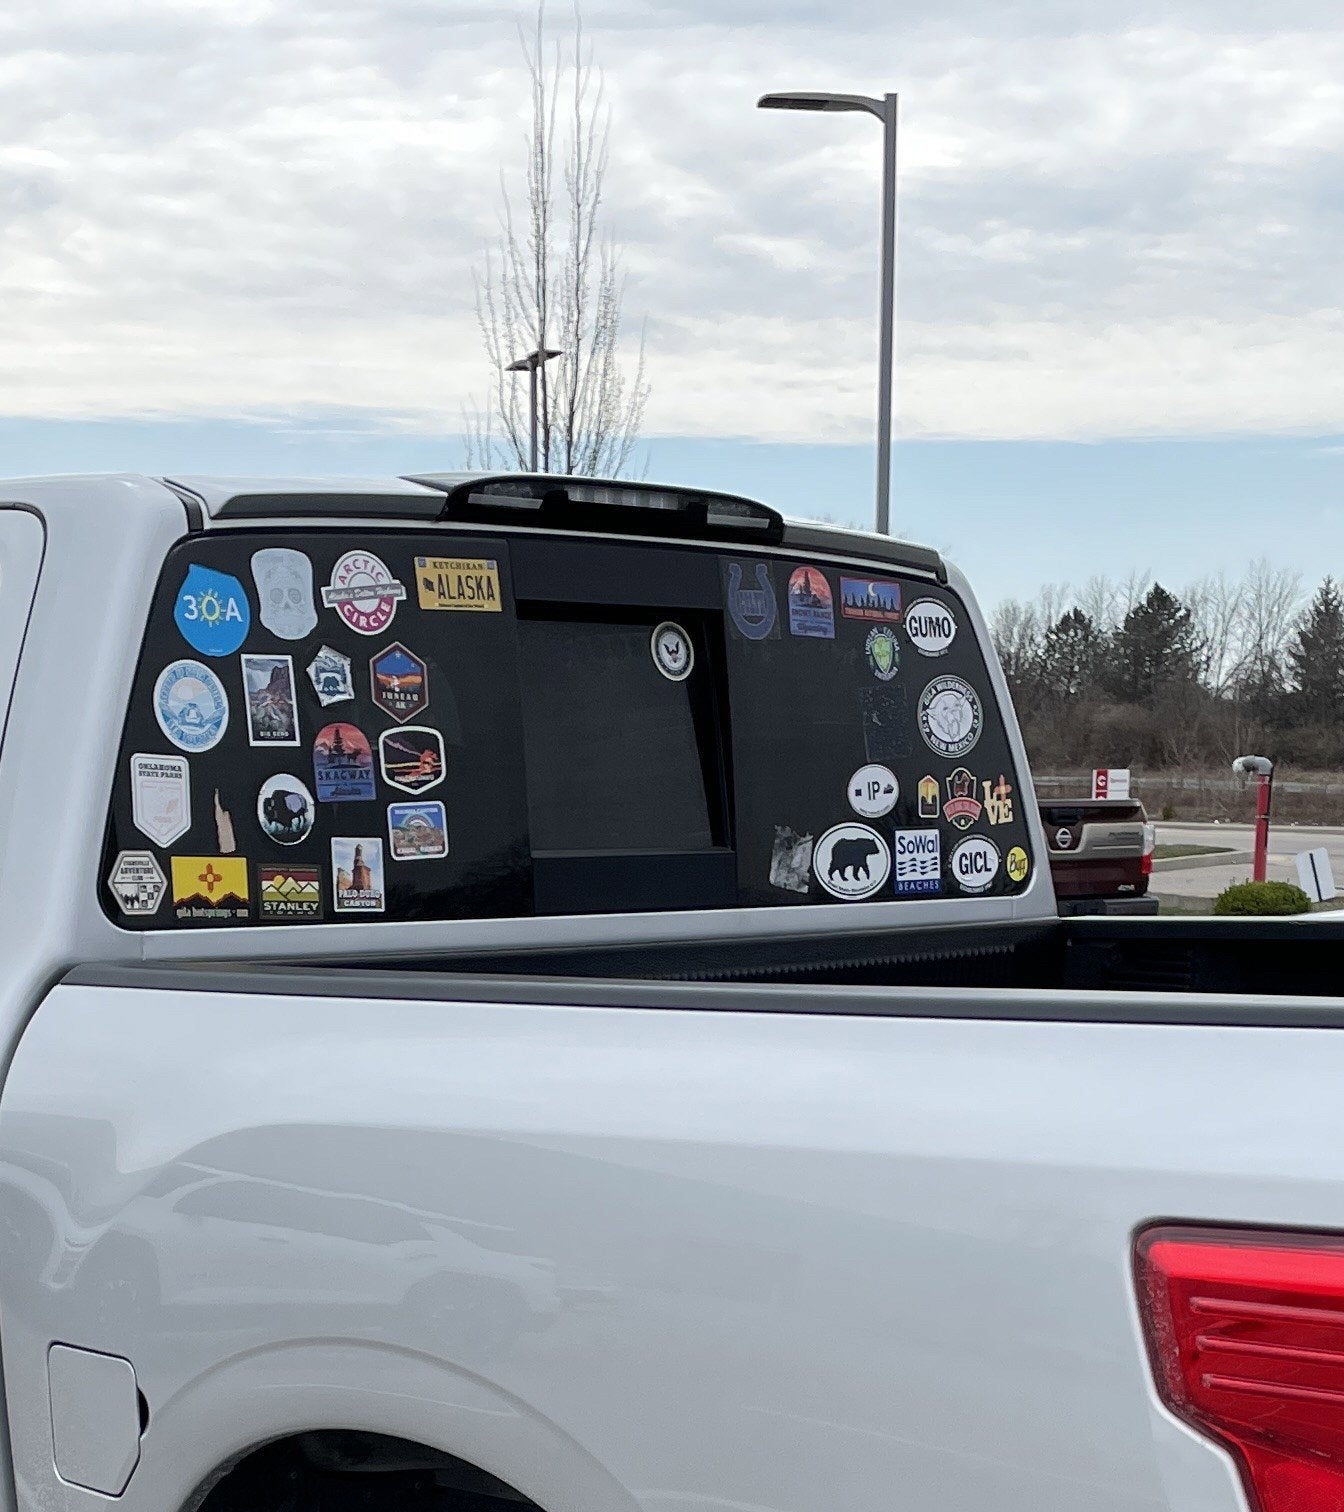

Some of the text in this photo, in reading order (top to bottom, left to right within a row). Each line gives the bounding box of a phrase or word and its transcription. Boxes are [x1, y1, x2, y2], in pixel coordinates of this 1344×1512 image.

[338, 557, 385, 586] ARCTIC
[437, 573, 496, 601] ALASKA
[183, 594, 244, 623] 30A
[344, 600, 393, 629] CIRCLE
[908, 615, 952, 639] GUMO
[897, 832, 939, 855] SoWal
[958, 850, 992, 876] GICL
[898, 881, 940, 891] BEACHES
[263, 901, 319, 911] STANLEY
